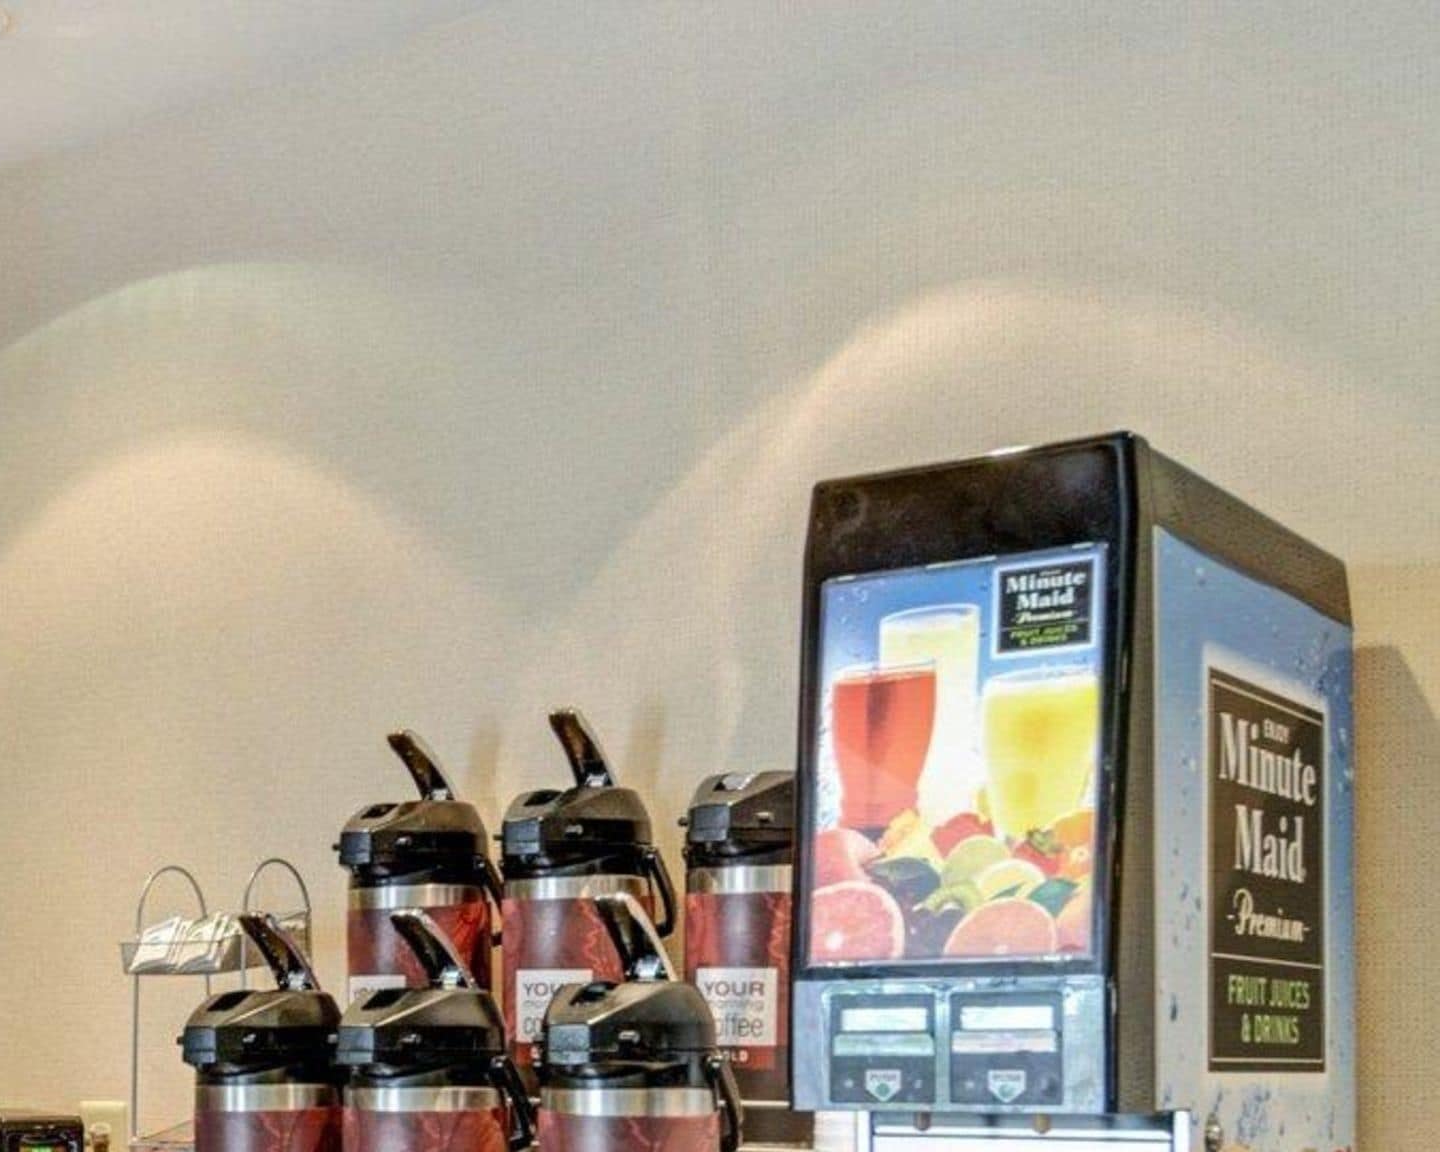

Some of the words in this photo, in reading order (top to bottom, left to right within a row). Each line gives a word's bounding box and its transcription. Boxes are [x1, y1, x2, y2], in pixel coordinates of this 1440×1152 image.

[1006, 572, 1087, 594] Minute
[1016, 586, 1075, 610] Maid
[1219, 712, 1317, 806] Minute
[1234, 804, 1306, 883] Maid
[1233, 888, 1305, 942] Premium
[704, 981, 764, 997] YOUR
[1228, 974, 1267, 1006] FRUIT
[1269, 979, 1310, 1010] JUICES
[1254, 1014, 1300, 1044] DRINKS
